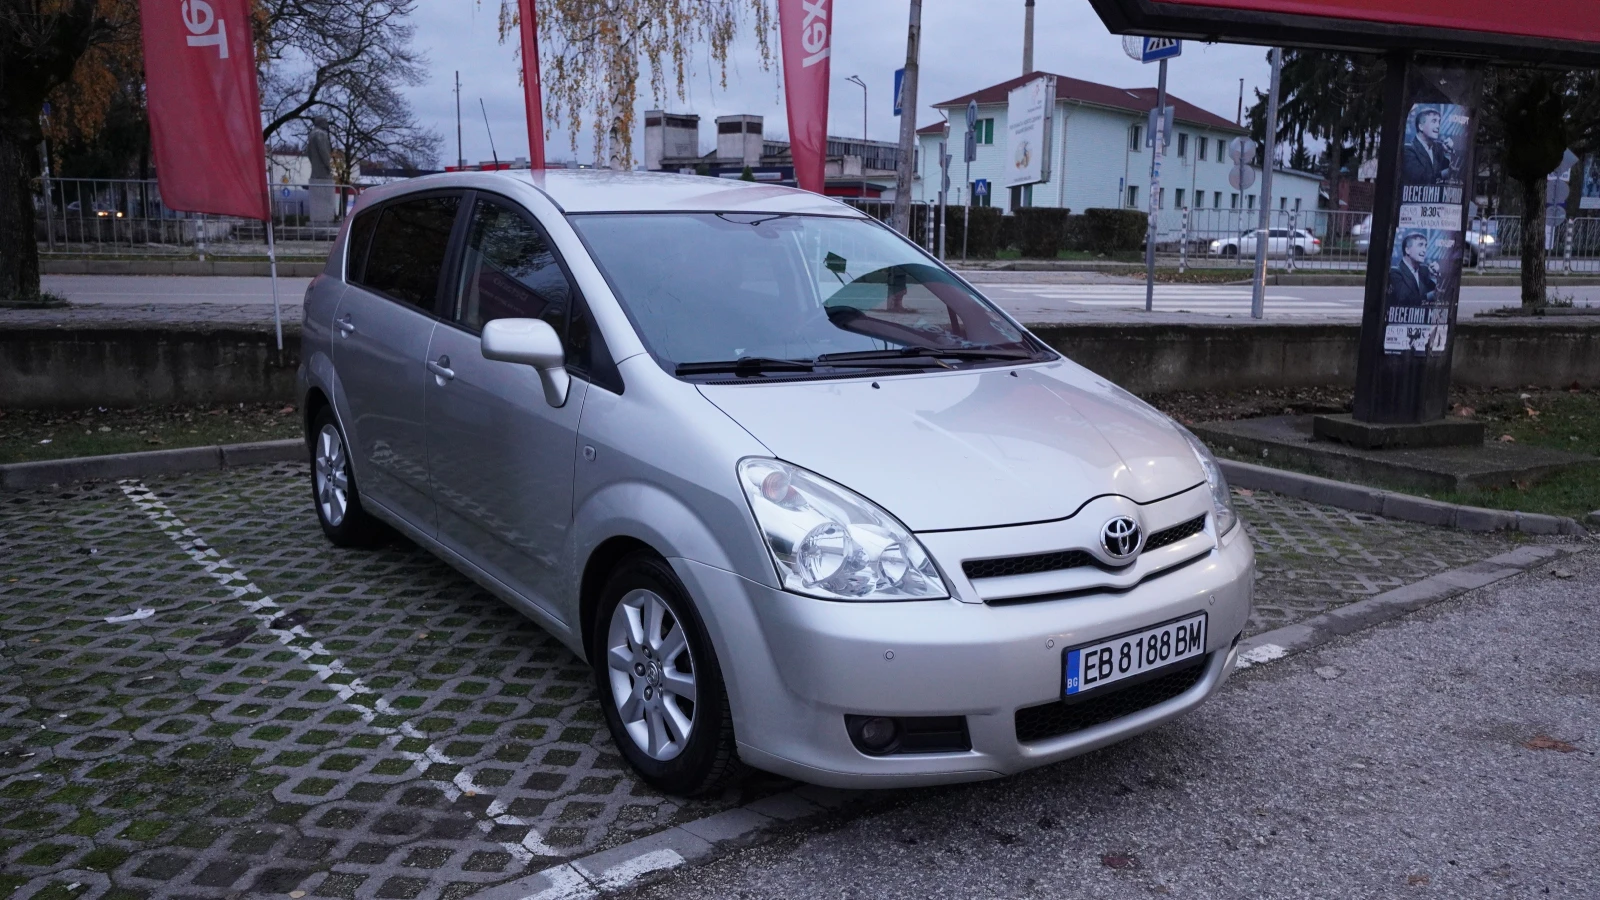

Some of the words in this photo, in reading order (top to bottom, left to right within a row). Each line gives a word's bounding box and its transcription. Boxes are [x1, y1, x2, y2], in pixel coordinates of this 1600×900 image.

[1083, 646, 1114, 685] EB
[1118, 630, 1171, 674] 8188
[1174, 620, 1202, 657] BM
[1067, 678, 1079, 689] BG
